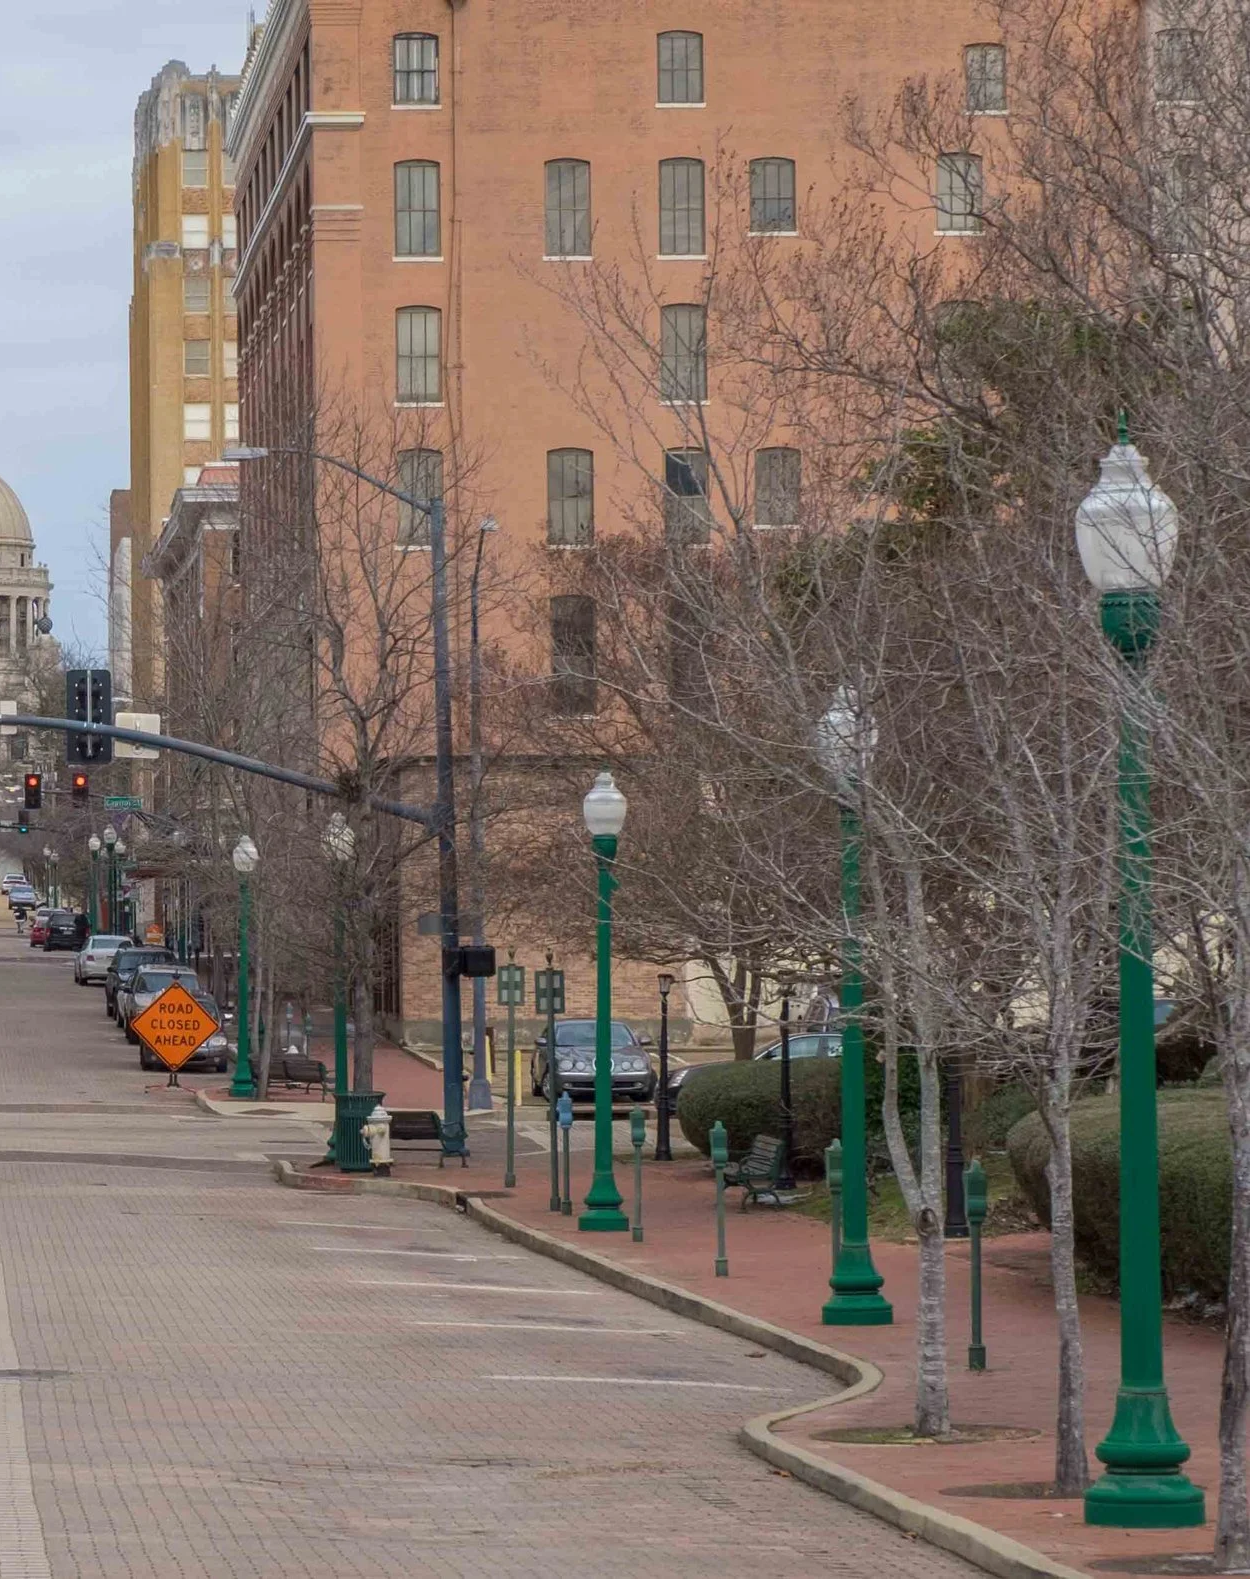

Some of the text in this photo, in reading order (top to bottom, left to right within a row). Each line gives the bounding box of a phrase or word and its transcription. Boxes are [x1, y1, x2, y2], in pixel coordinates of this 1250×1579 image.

[159, 1003, 193, 1014] ROAD
[150, 1018, 200, 1031] CLOSED
[154, 1035, 196, 1046] AHEAD
